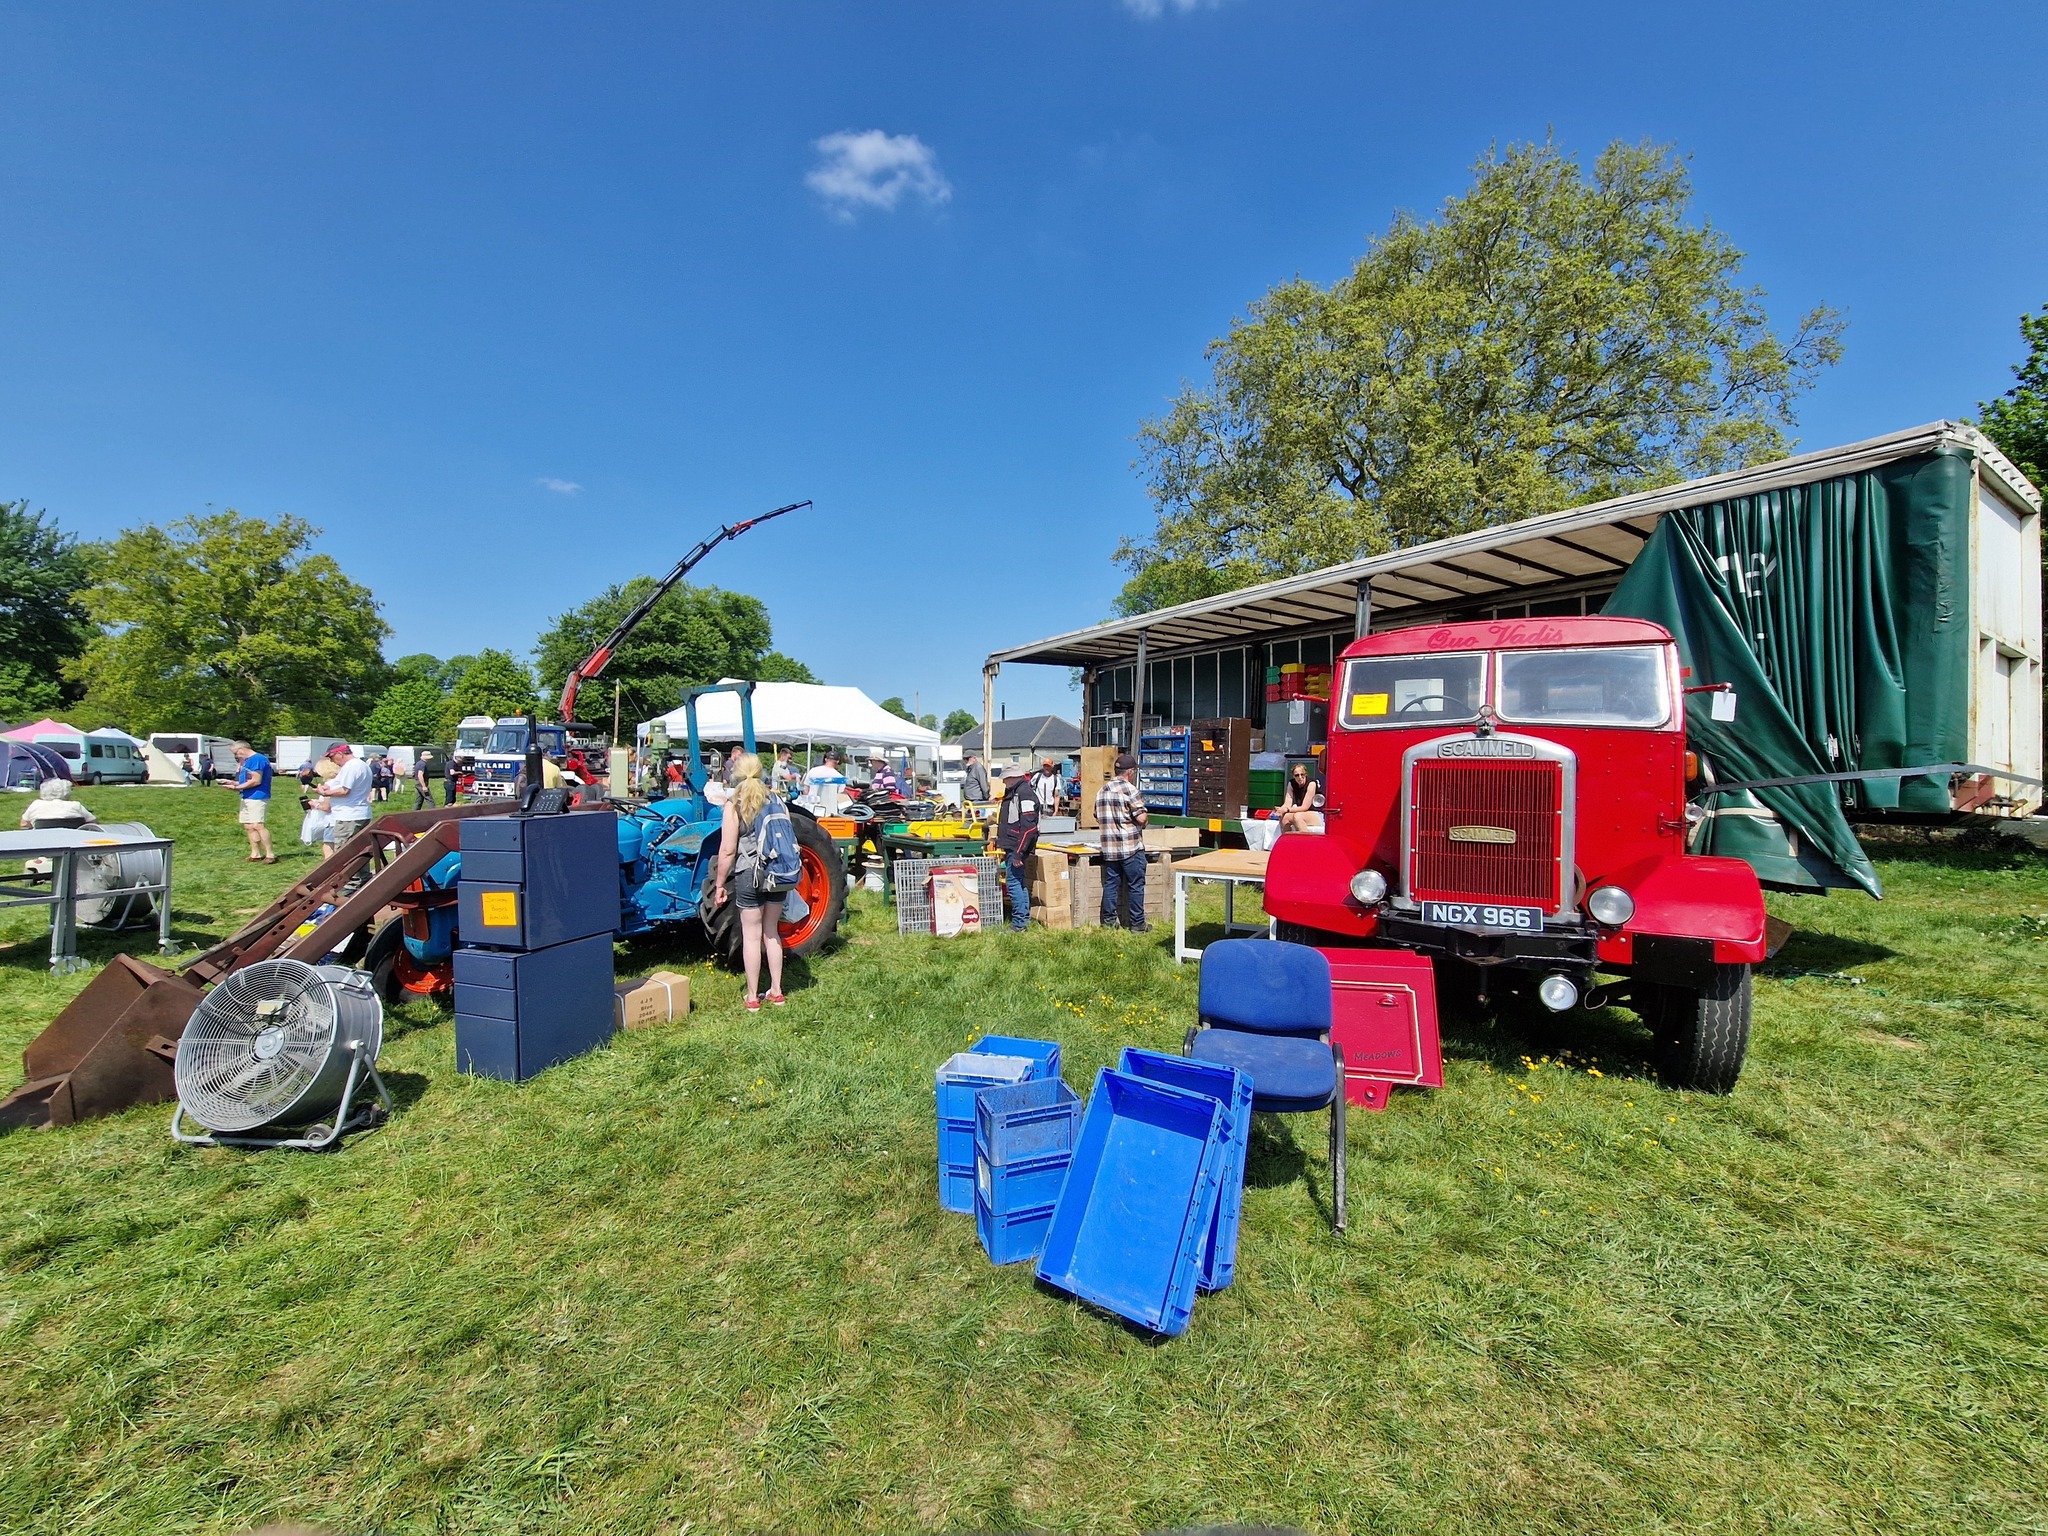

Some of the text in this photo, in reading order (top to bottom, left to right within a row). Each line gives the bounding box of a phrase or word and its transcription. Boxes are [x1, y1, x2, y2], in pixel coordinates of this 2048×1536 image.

[1427, 624, 1563, 649] Quo Vadis
[1441, 740, 1532, 757] SCAMMELL
[1450, 828, 1514, 841] SCAMMELL
[1432, 904, 1531, 928] NGX 966
